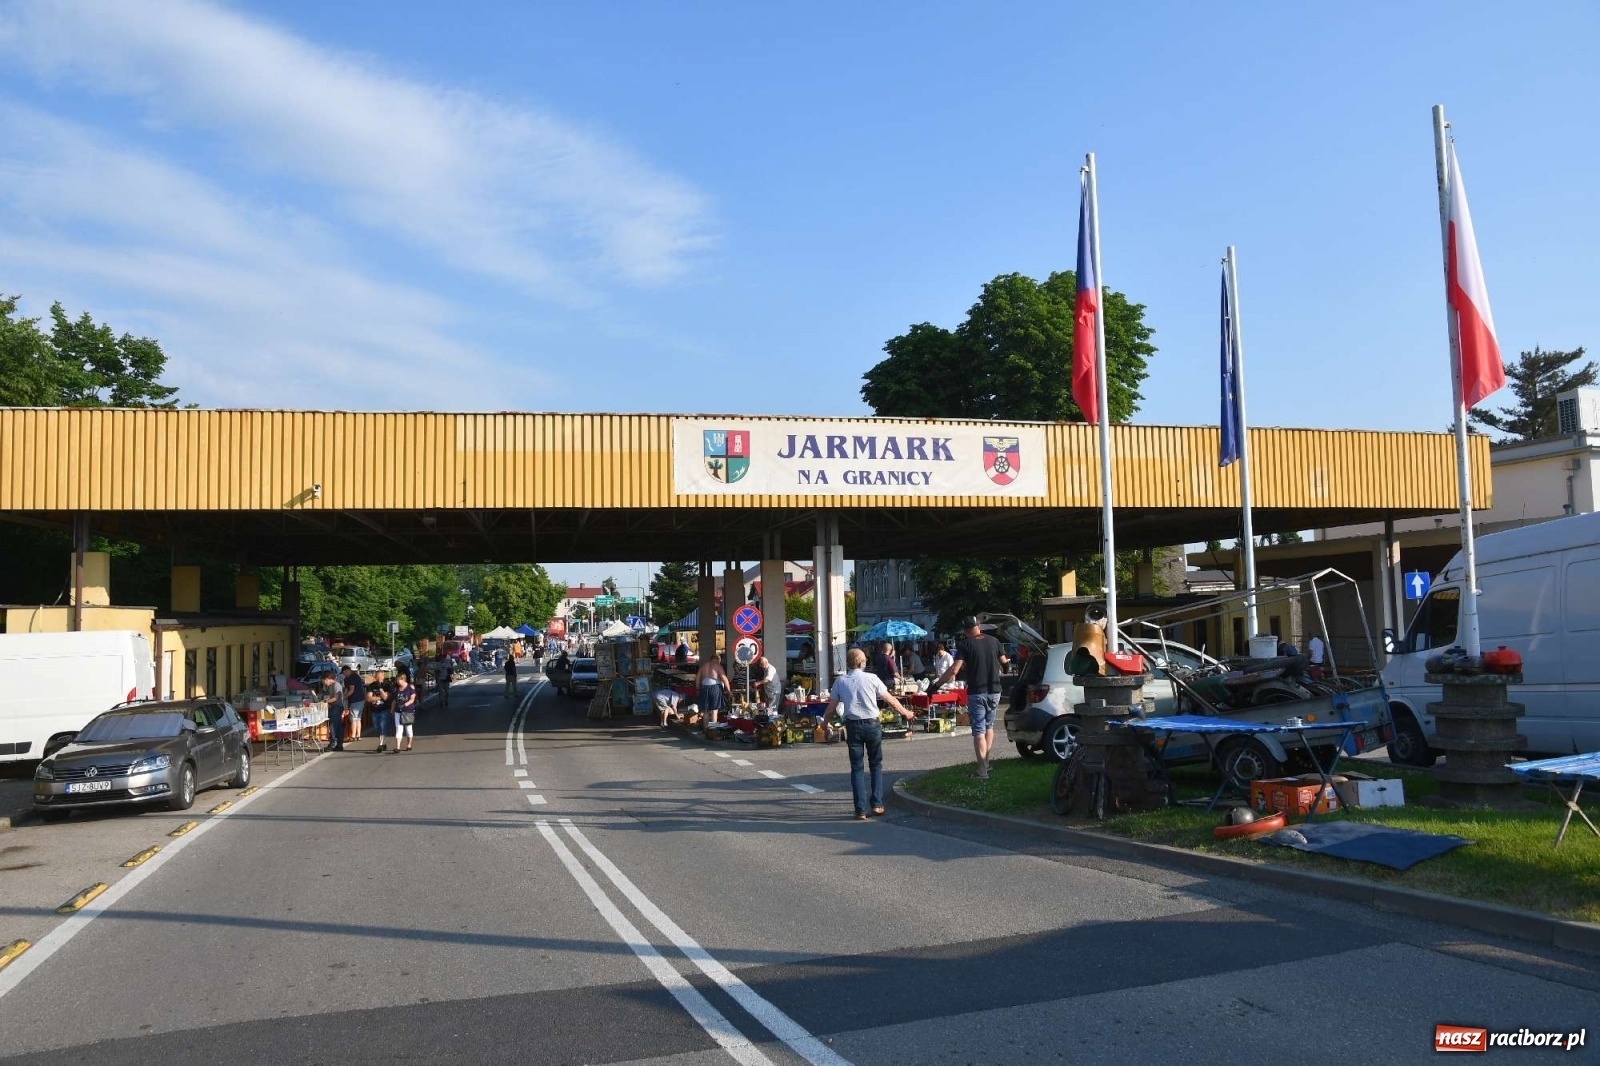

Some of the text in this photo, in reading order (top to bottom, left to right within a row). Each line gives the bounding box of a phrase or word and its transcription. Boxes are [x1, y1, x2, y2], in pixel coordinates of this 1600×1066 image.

[777, 434, 955, 461] JARMARK
[798, 469, 933, 486] NA GRANICY
